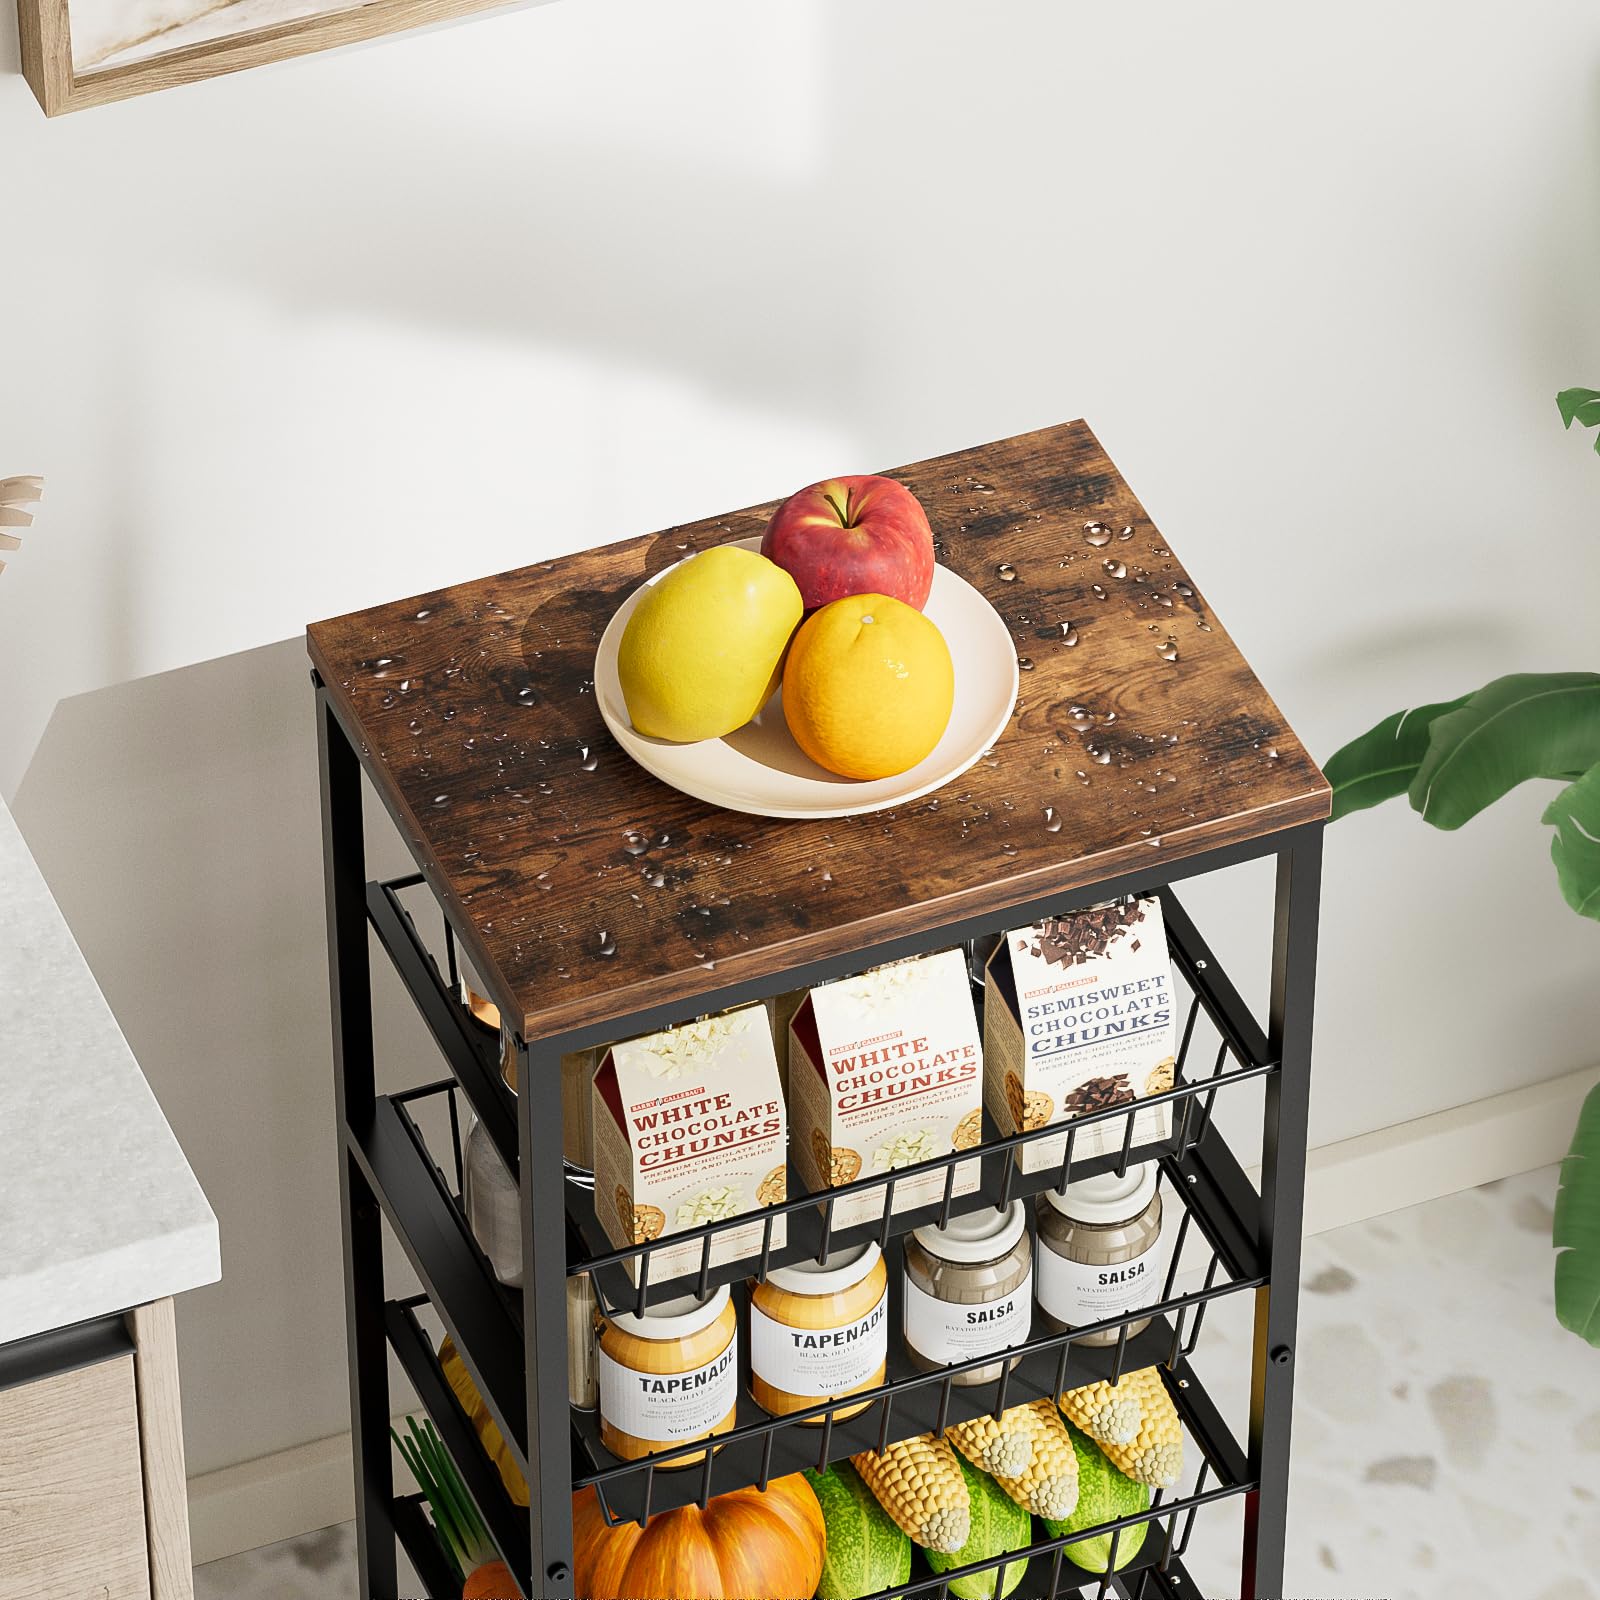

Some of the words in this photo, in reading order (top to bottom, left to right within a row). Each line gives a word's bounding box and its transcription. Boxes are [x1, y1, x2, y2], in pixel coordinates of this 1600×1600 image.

[1028, 975, 1165, 1019] SEMISWEET
[1030, 992, 1169, 1036] CHOCOLATE
[830, 1044, 855, 1056] BARRY
[861, 1030, 902, 1047] CALLEBAUT
[1032, 1009, 1170, 1053] CHUNKS
[1035, 1049, 1082, 1066] PREMIUM
[1085, 1036, 1143, 1054] CHOCOLATE
[1147, 1030, 1166, 1039] FOR
[832, 1036, 929, 1075] WHITE
[836, 1044, 976, 1092] CHOCOLATE
[1038, 1055, 1089, 1072] DESSERTS
[1091, 1049, 1112, 1059] AND
[1115, 1038, 1163, 1053] PASTRIES
[631, 1100, 656, 1112] BARRY
[662, 1087, 705, 1104] CALLEBAUT
[837, 1061, 977, 1110] CHUNKS
[841, 1106, 889, 1123] PREMIUM
[892, 1090, 949, 1110] CHOCOLATE
[953, 1083, 973, 1092] FOR
[633, 1093, 732, 1132] WHITE
[638, 1101, 779, 1149] CHOCOLATE
[845, 1112, 895, 1129] DESSERTS
[898, 1105, 920, 1115] AND
[922, 1091, 969, 1108] PASTRIES
[640, 1118, 781, 1166] CHUNKS
[643, 1162, 692, 1180] PREMIUM
[694, 1146, 754, 1166] CHOCOLATE
[757, 1139, 777, 1148] FOR
[647, 1168, 698, 1185] DESSERTS
[700, 1161, 723, 1171] AND
[725, 1147, 773, 1165] PASTRIES
[1098, 1262, 1145, 1286] SALSA
[791, 1301, 886, 1349] TAPENADE
[966, 1300, 1014, 1324] SALSA
[639, 1346, 734, 1394] TAPENADE
[831, 1345, 855, 1357] OLIVE
[679, 1390, 704, 1401] OLIVE
[818, 1379, 852, 1389] Nicolas
[667, 1424, 702, 1434] Nicolas
